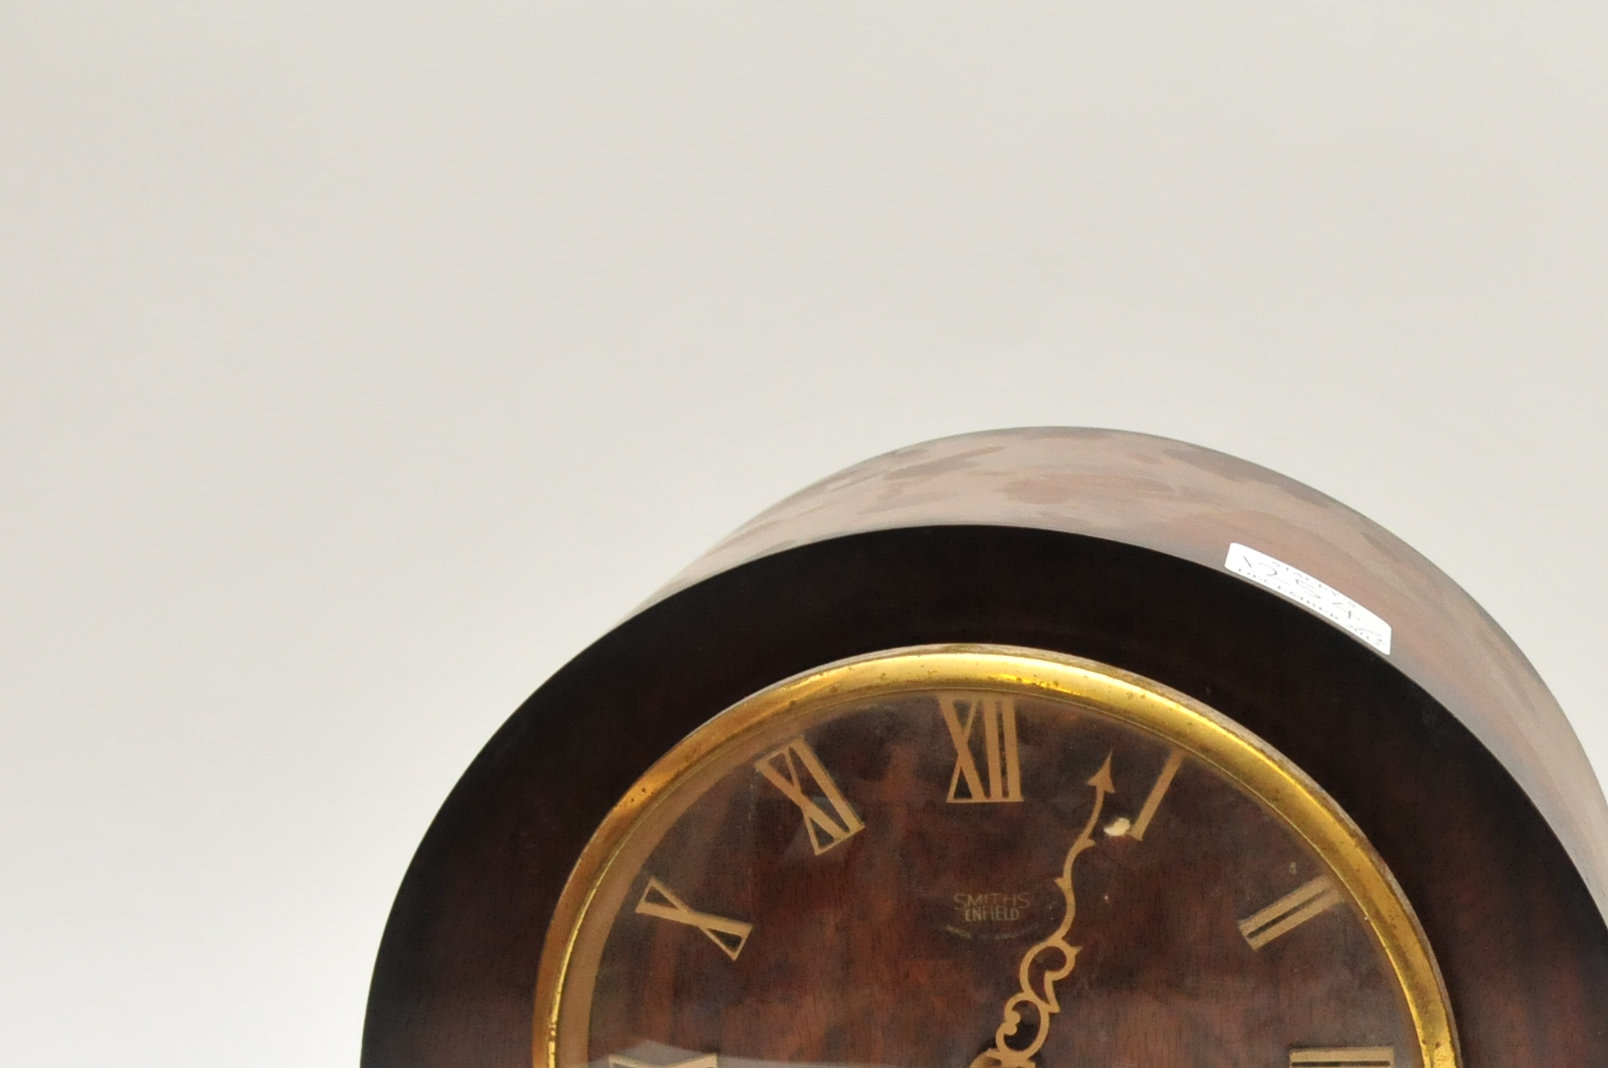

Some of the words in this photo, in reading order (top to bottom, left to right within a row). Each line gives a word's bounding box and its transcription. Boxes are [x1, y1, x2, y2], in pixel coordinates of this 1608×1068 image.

[938, 697, 1024, 803] XII
[755, 736, 865, 856] XI
[635, 877, 752, 961] X
[953, 892, 1031, 910] SMITHS
[964, 906, 1020, 921] ENFIELD
[1238, 873, 1344, 952] II
